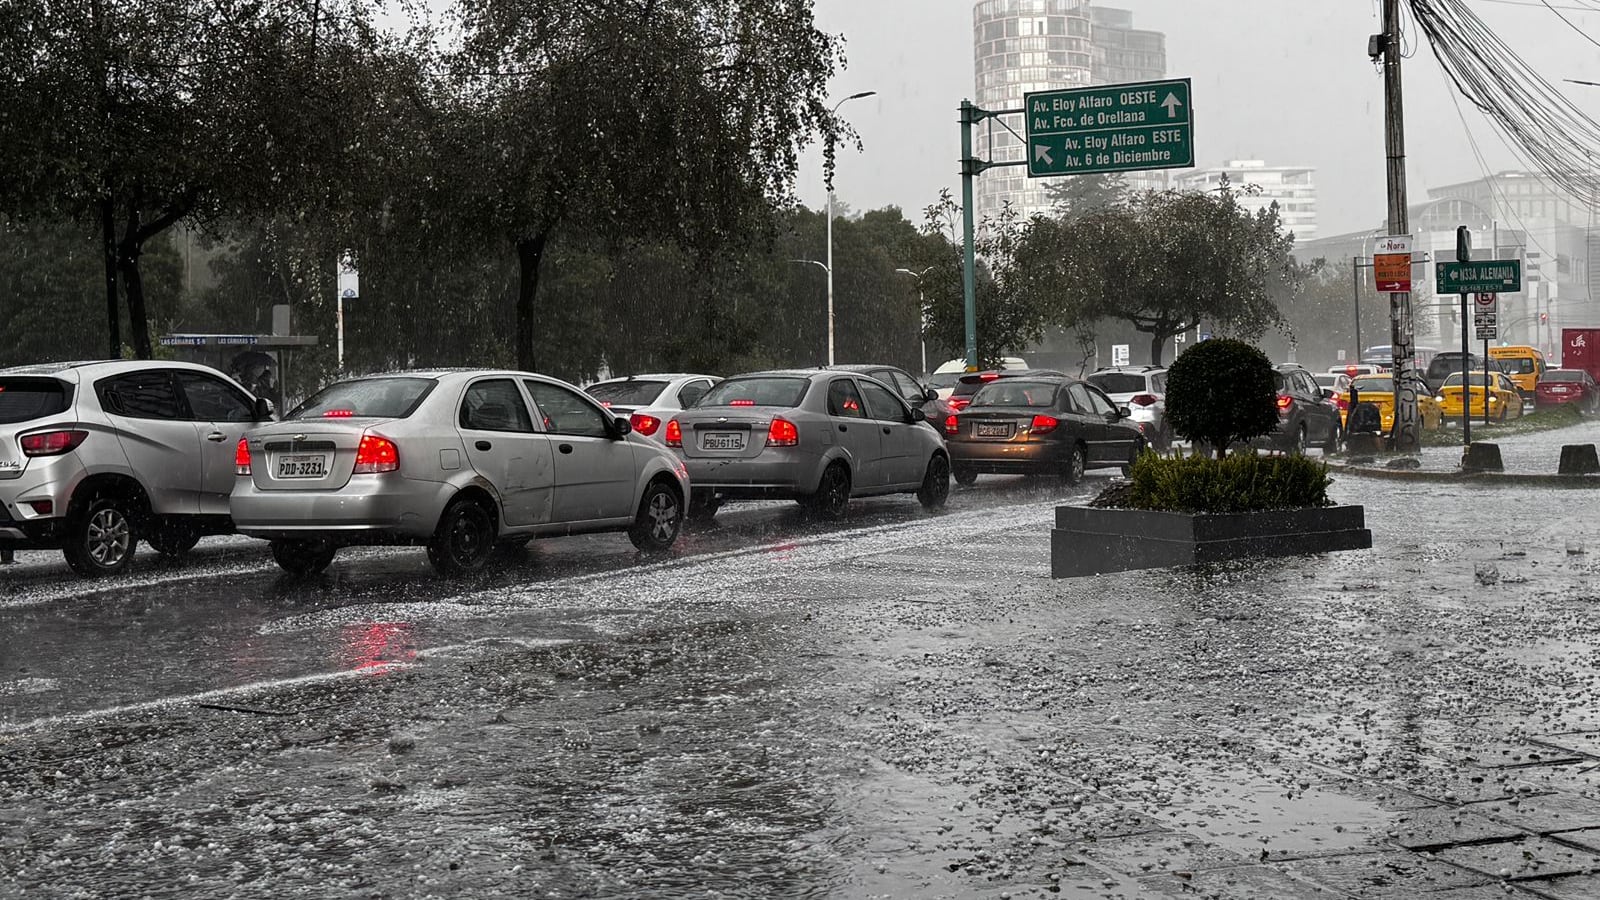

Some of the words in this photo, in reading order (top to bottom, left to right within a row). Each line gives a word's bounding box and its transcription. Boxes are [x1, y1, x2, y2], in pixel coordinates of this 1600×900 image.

[1033, 100, 1049, 113] Av.
[1053, 98, 1075, 112] Eloy
[1078, 96, 1113, 109] Alfaro
[1120, 91, 1156, 105] OESTE
[1034, 117, 1050, 130] Av.
[1053, 116, 1077, 129] Fco.
[1080, 113, 1094, 126] de
[1097, 111, 1145, 125] Orellana
[1065, 137, 1081, 150] Av.
[1085, 136, 1107, 150] Eloy
[1111, 133, 1145, 147] Alfaro
[1152, 129, 1181, 143] ESTE
[1065, 155, 1082, 168] Av.
[1085, 153, 1092, 166] 6
[1096, 152, 1110, 165] de
[1113, 149, 1171, 164] Diciembre
[1480, 265, 1514, 281] ALEMANIA
[705, 438, 740, 448] PBU-6115
[279, 462, 322, 475] PDD-3231
